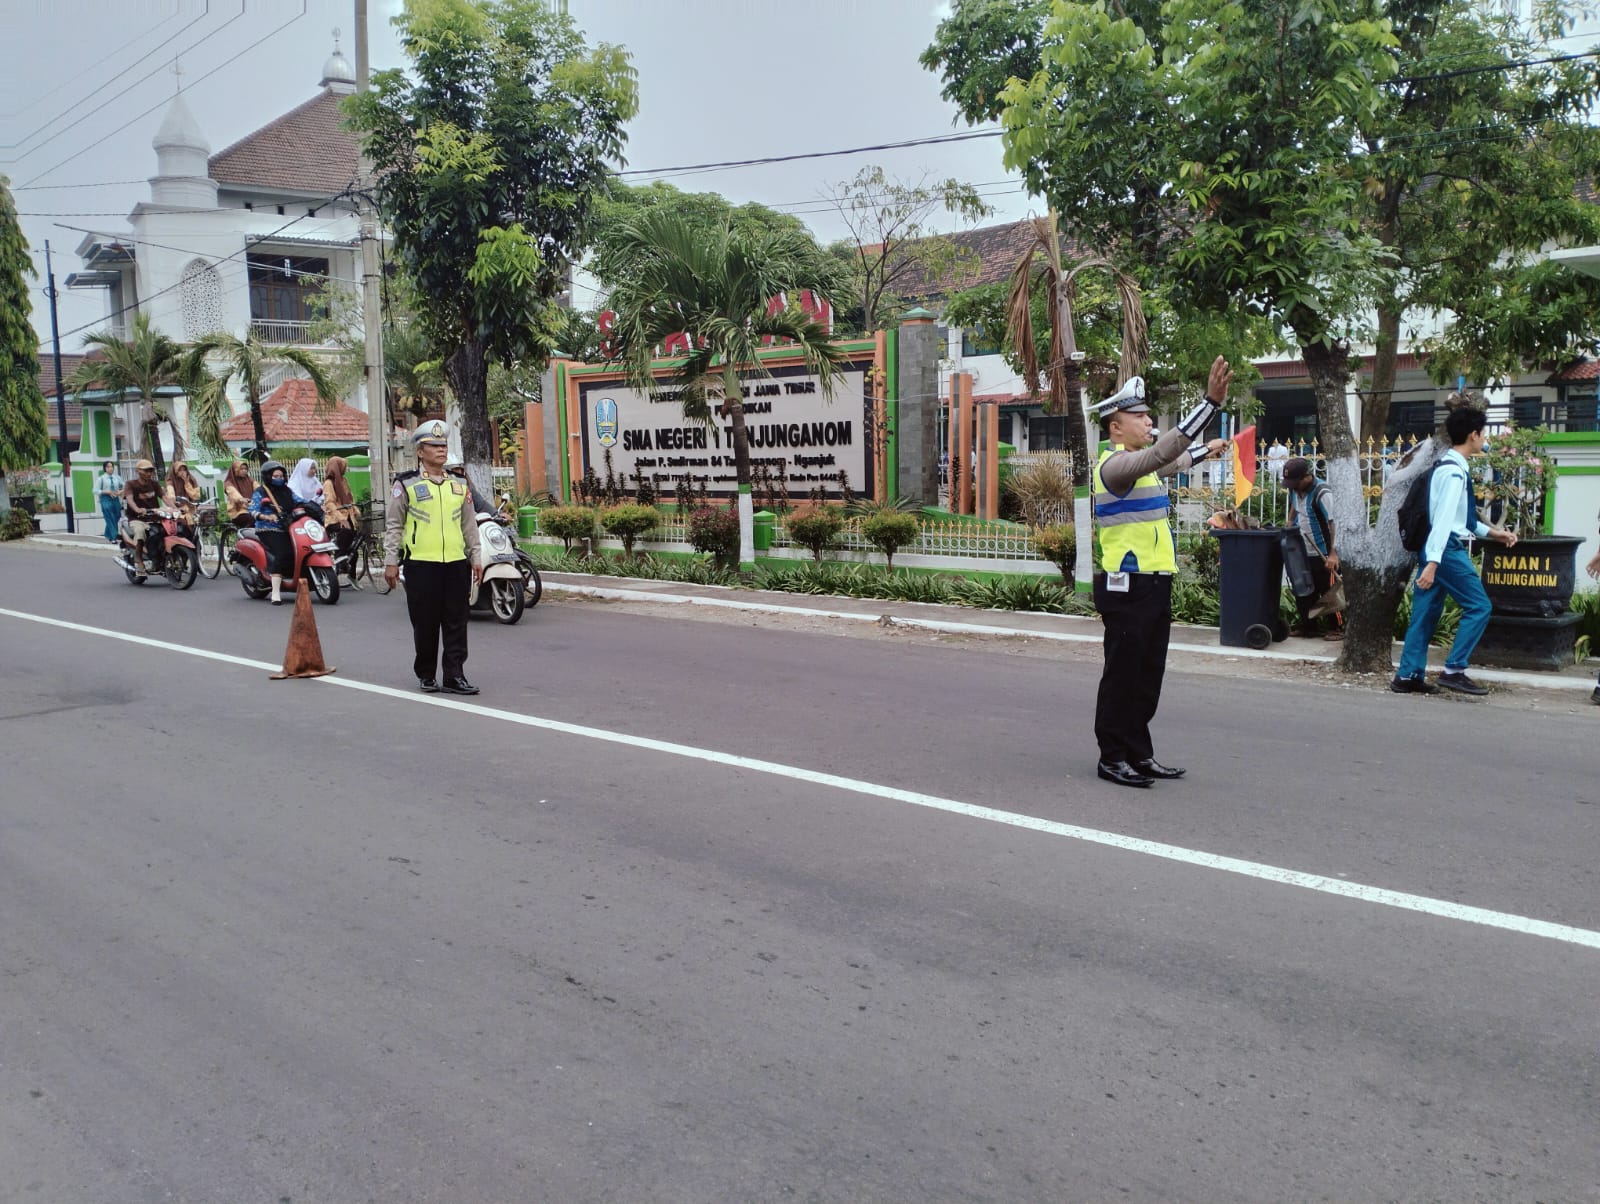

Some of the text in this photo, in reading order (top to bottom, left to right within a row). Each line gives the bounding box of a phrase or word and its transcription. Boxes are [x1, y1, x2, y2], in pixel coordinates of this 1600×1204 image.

[753, 384, 781, 396] JAWA
[623, 429, 653, 451] SMA
[655, 427, 707, 450] NEGERI
[724, 421, 852, 448] TNJUNGANOM
[794, 453, 835, 468] Nganjuk
[1494, 556, 1550, 571] SMAN 1
[1487, 572, 1558, 587] TANJUNGANOM
